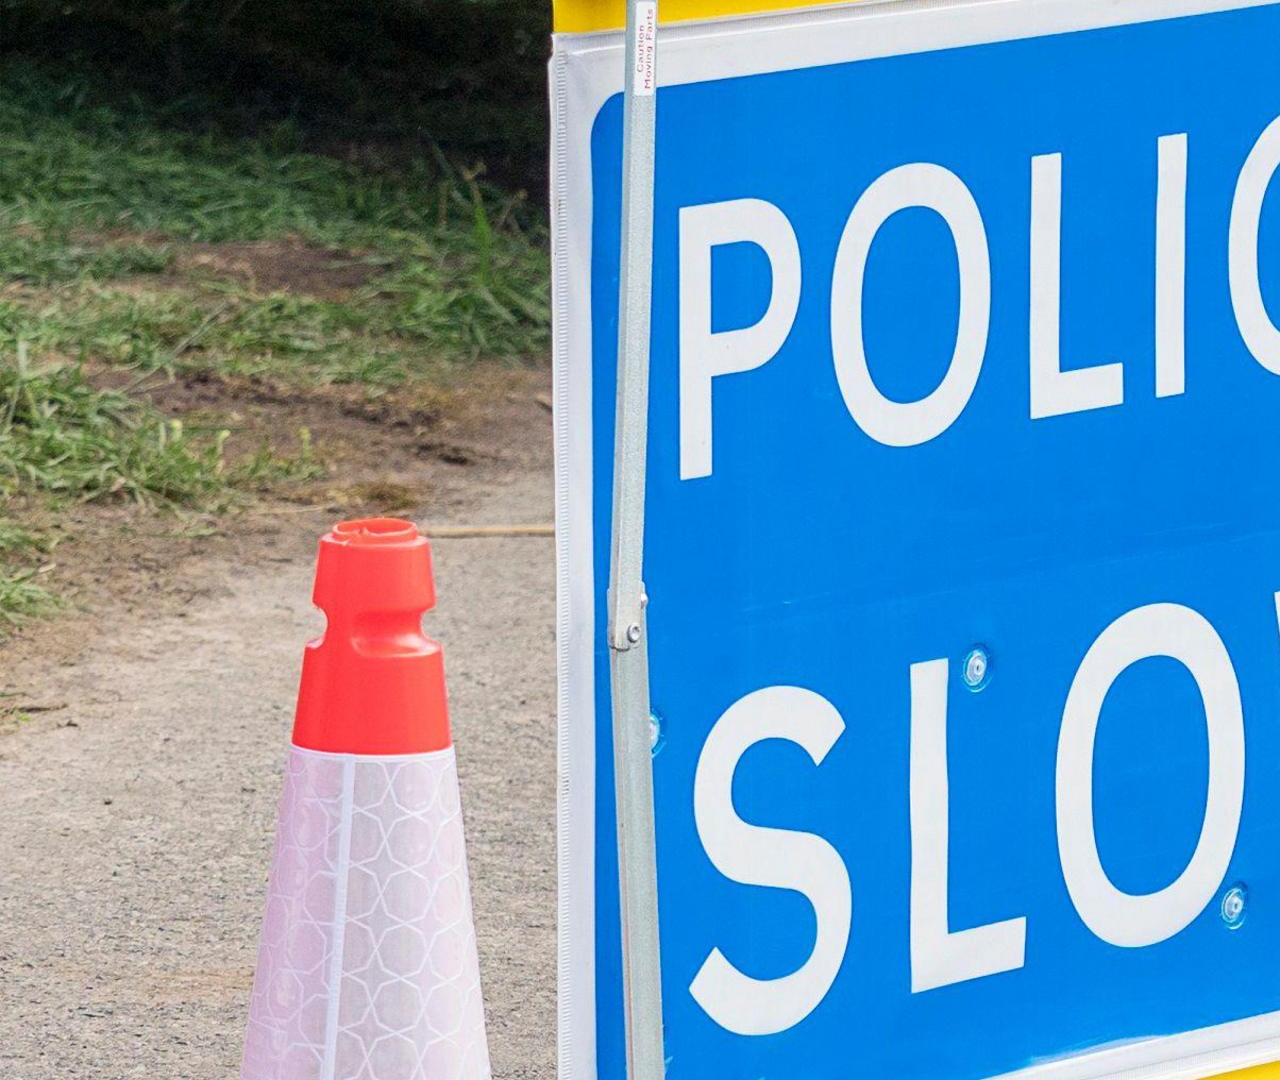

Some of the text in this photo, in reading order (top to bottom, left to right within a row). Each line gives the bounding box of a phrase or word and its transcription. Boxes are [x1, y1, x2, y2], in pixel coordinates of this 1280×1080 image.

[636, 25, 646, 73] Caution
[644, 8, 654, 89] Moving Parts
